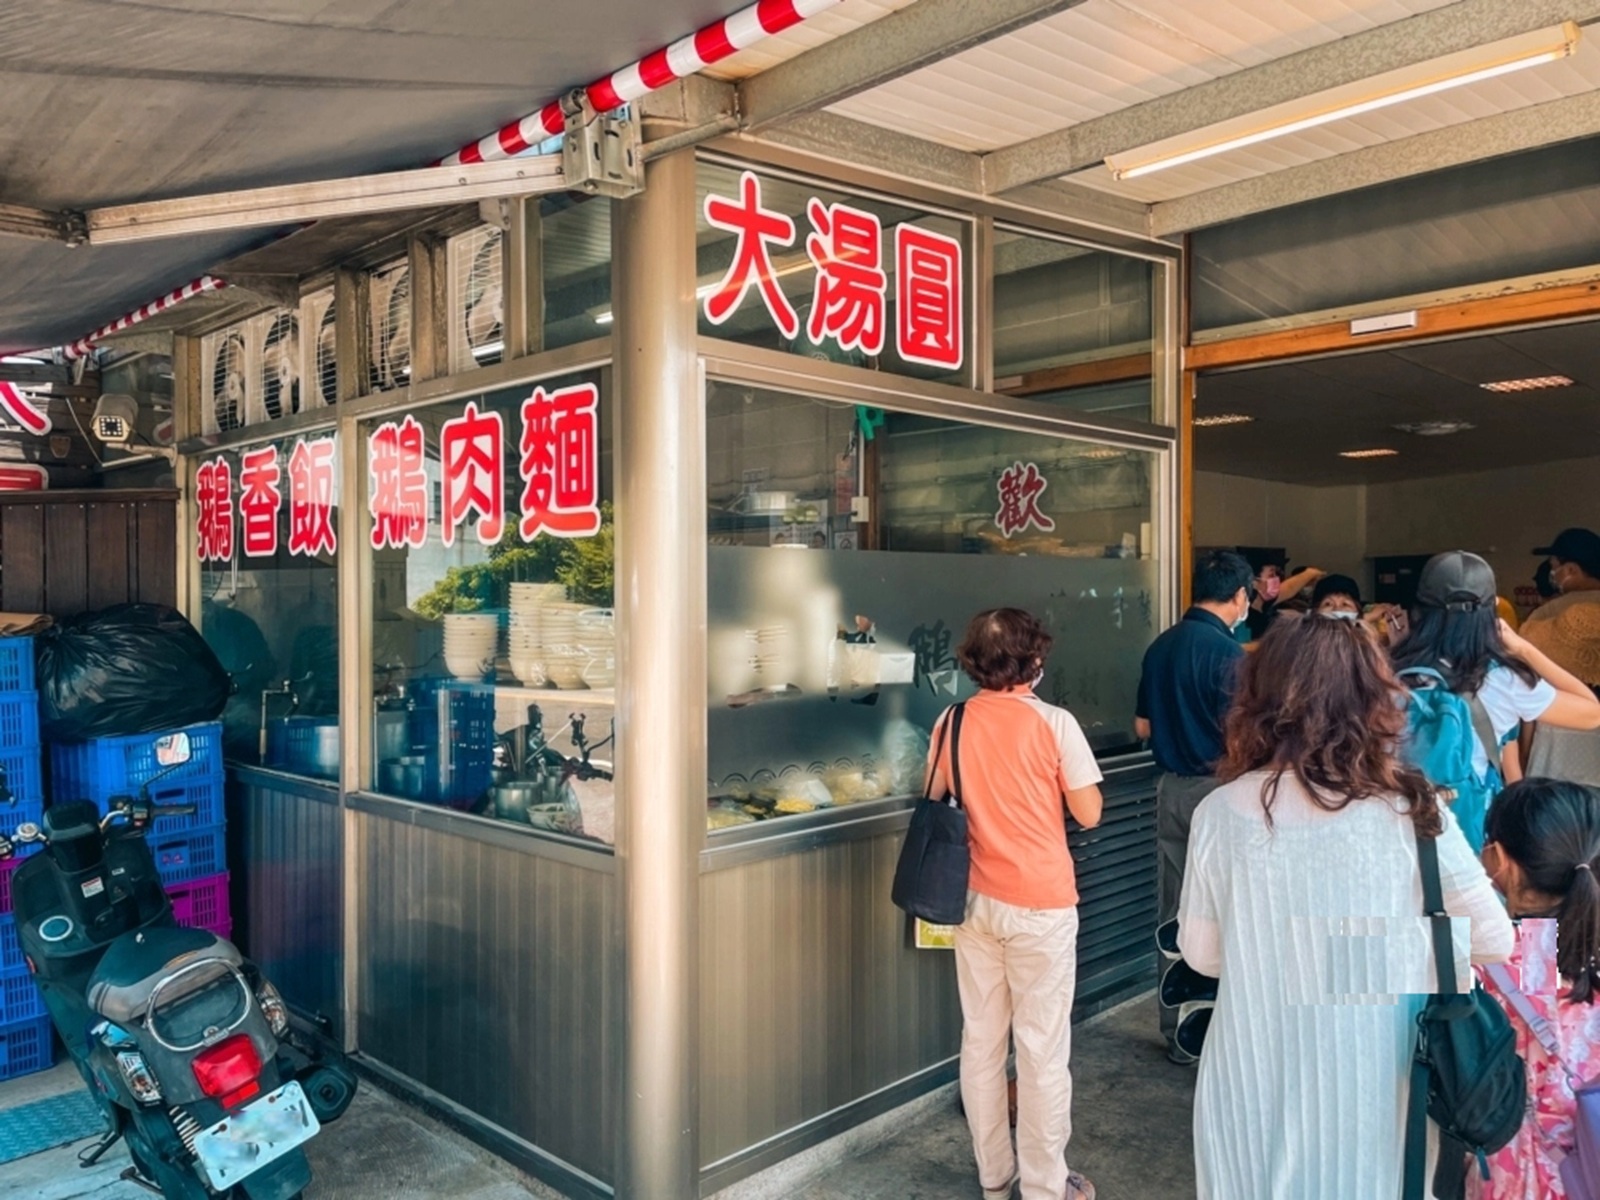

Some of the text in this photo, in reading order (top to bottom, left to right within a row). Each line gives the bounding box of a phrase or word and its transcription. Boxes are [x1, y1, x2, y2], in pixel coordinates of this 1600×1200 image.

[703, 171, 964, 370] 大湯圓
[196, 382, 601, 562] 鵝香飯 鵝肉麵
[995, 461, 1056, 539] 歡
